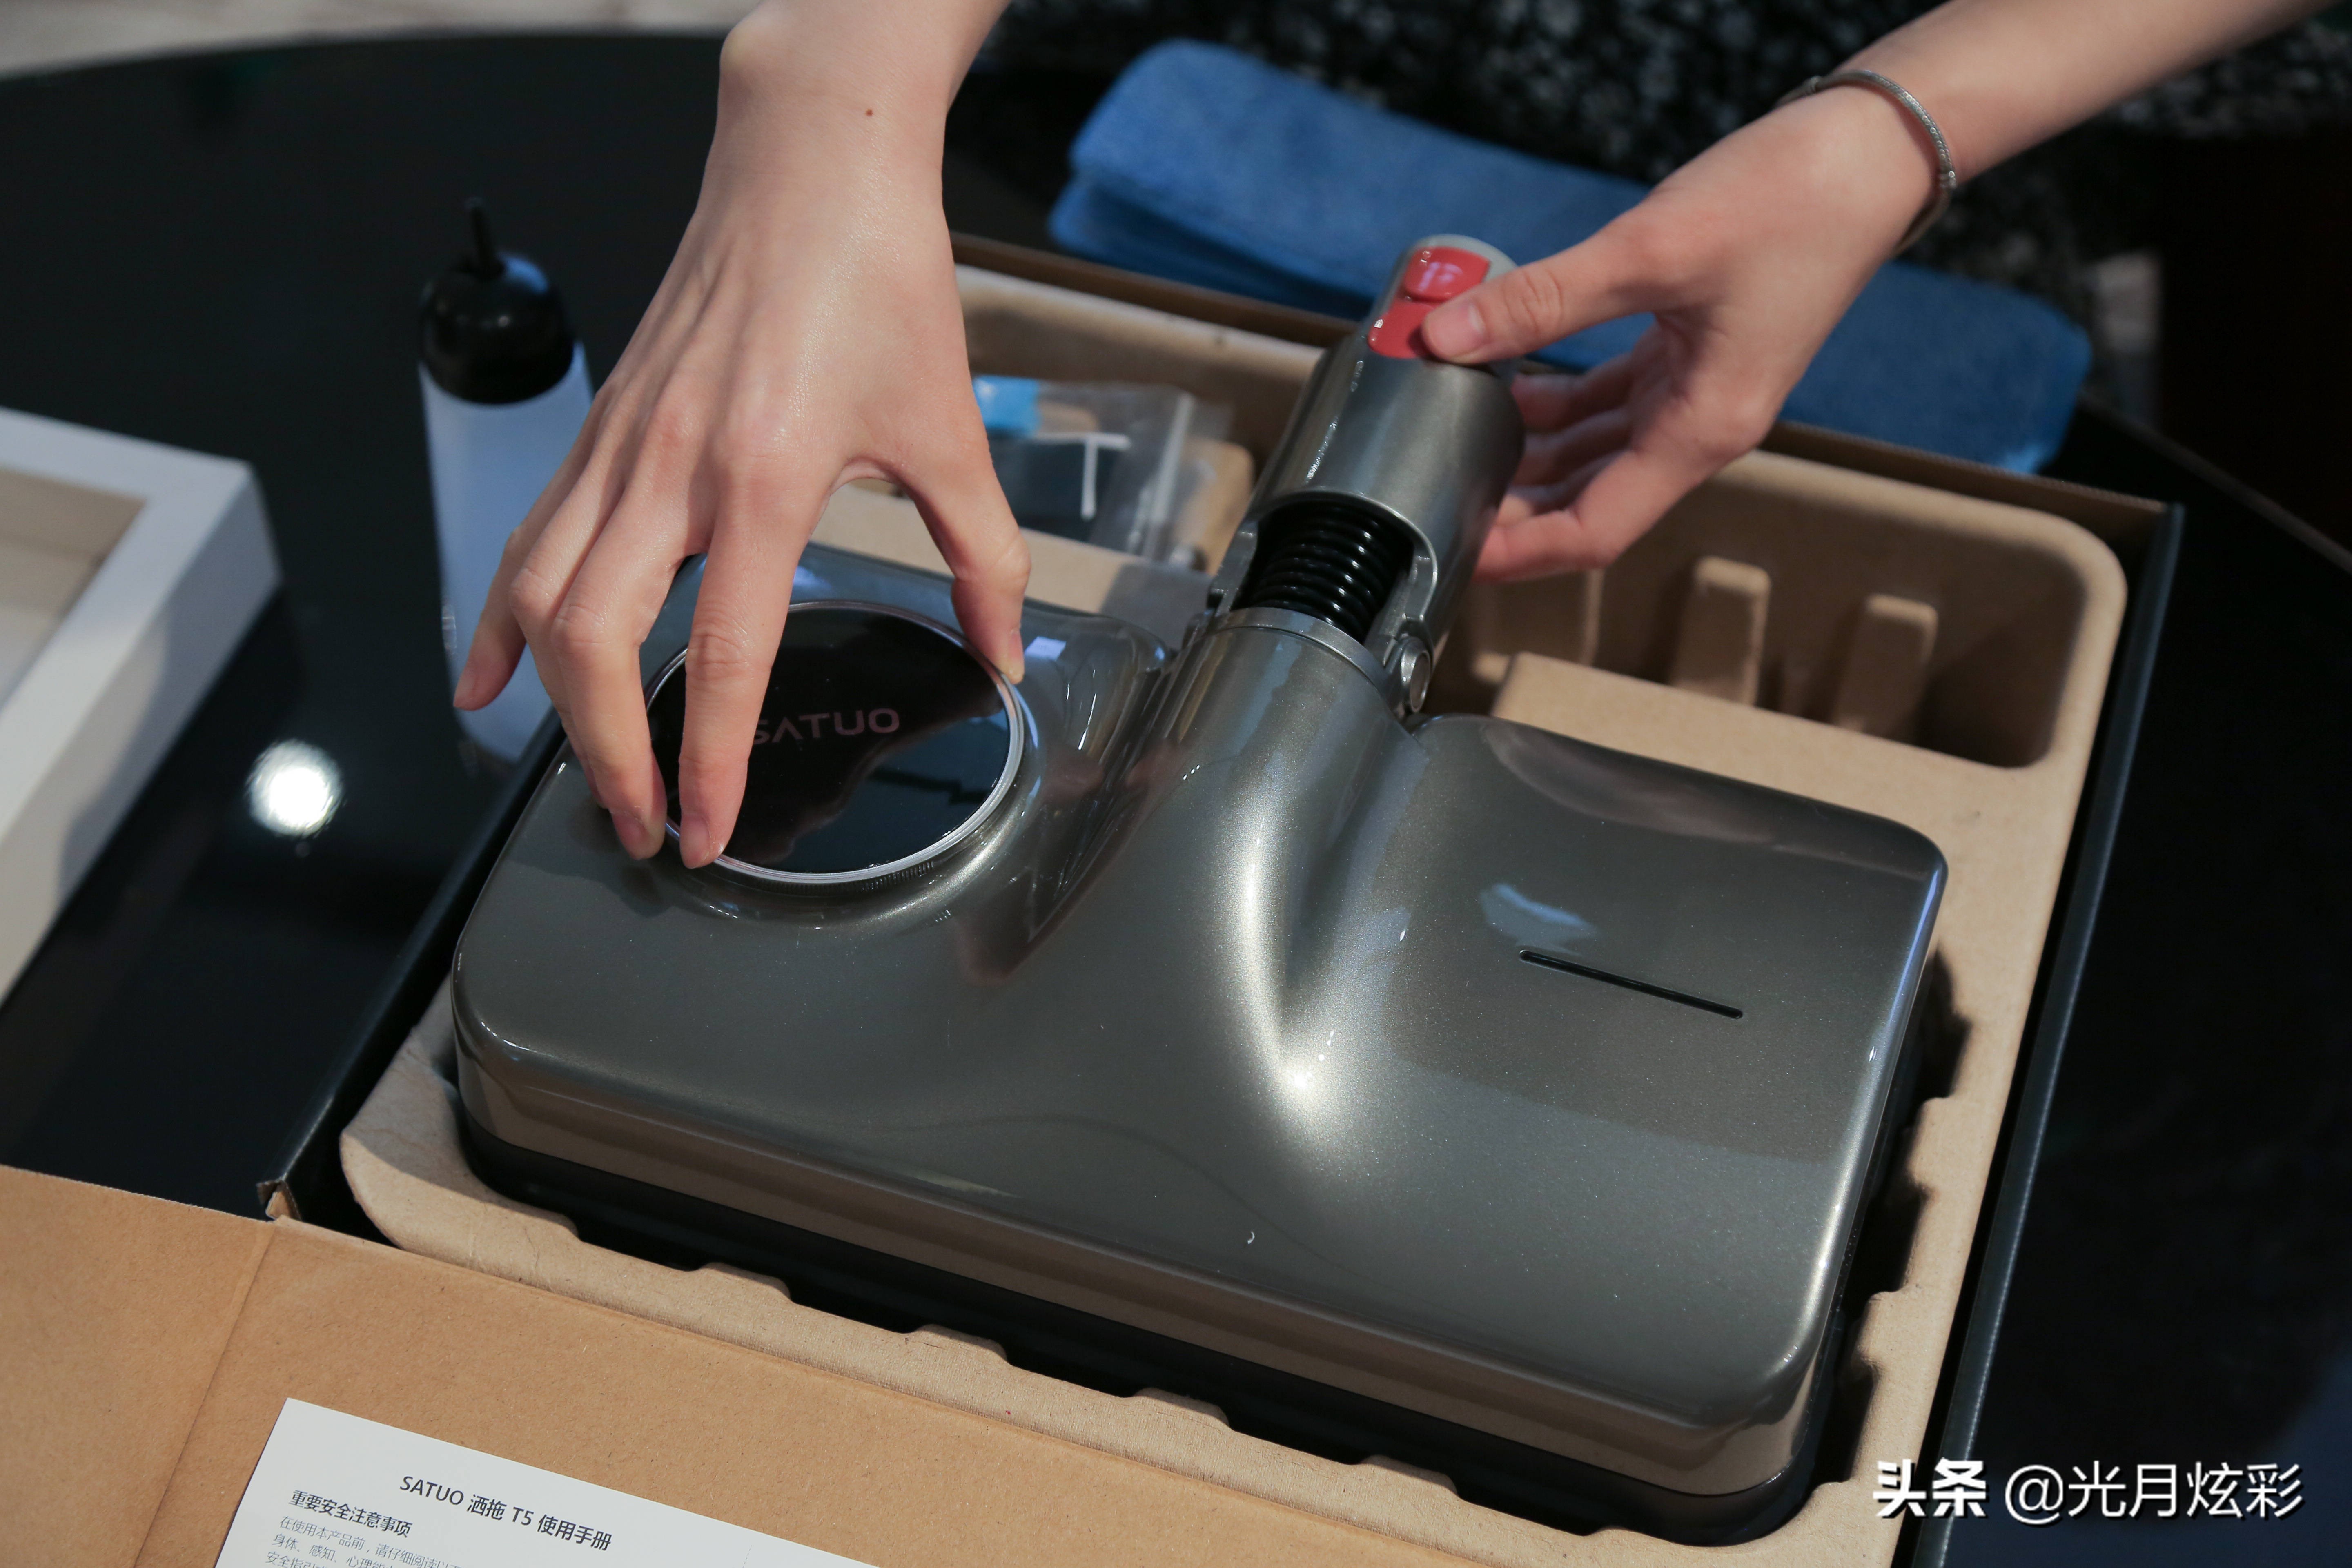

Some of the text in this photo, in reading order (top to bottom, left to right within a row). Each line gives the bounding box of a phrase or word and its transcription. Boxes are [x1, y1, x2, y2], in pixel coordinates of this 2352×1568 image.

[288, 1489, 413, 1539] 重要安全注意事项
[400, 1475, 612, 1551] SATUO 洒拖 T5 使用手册
